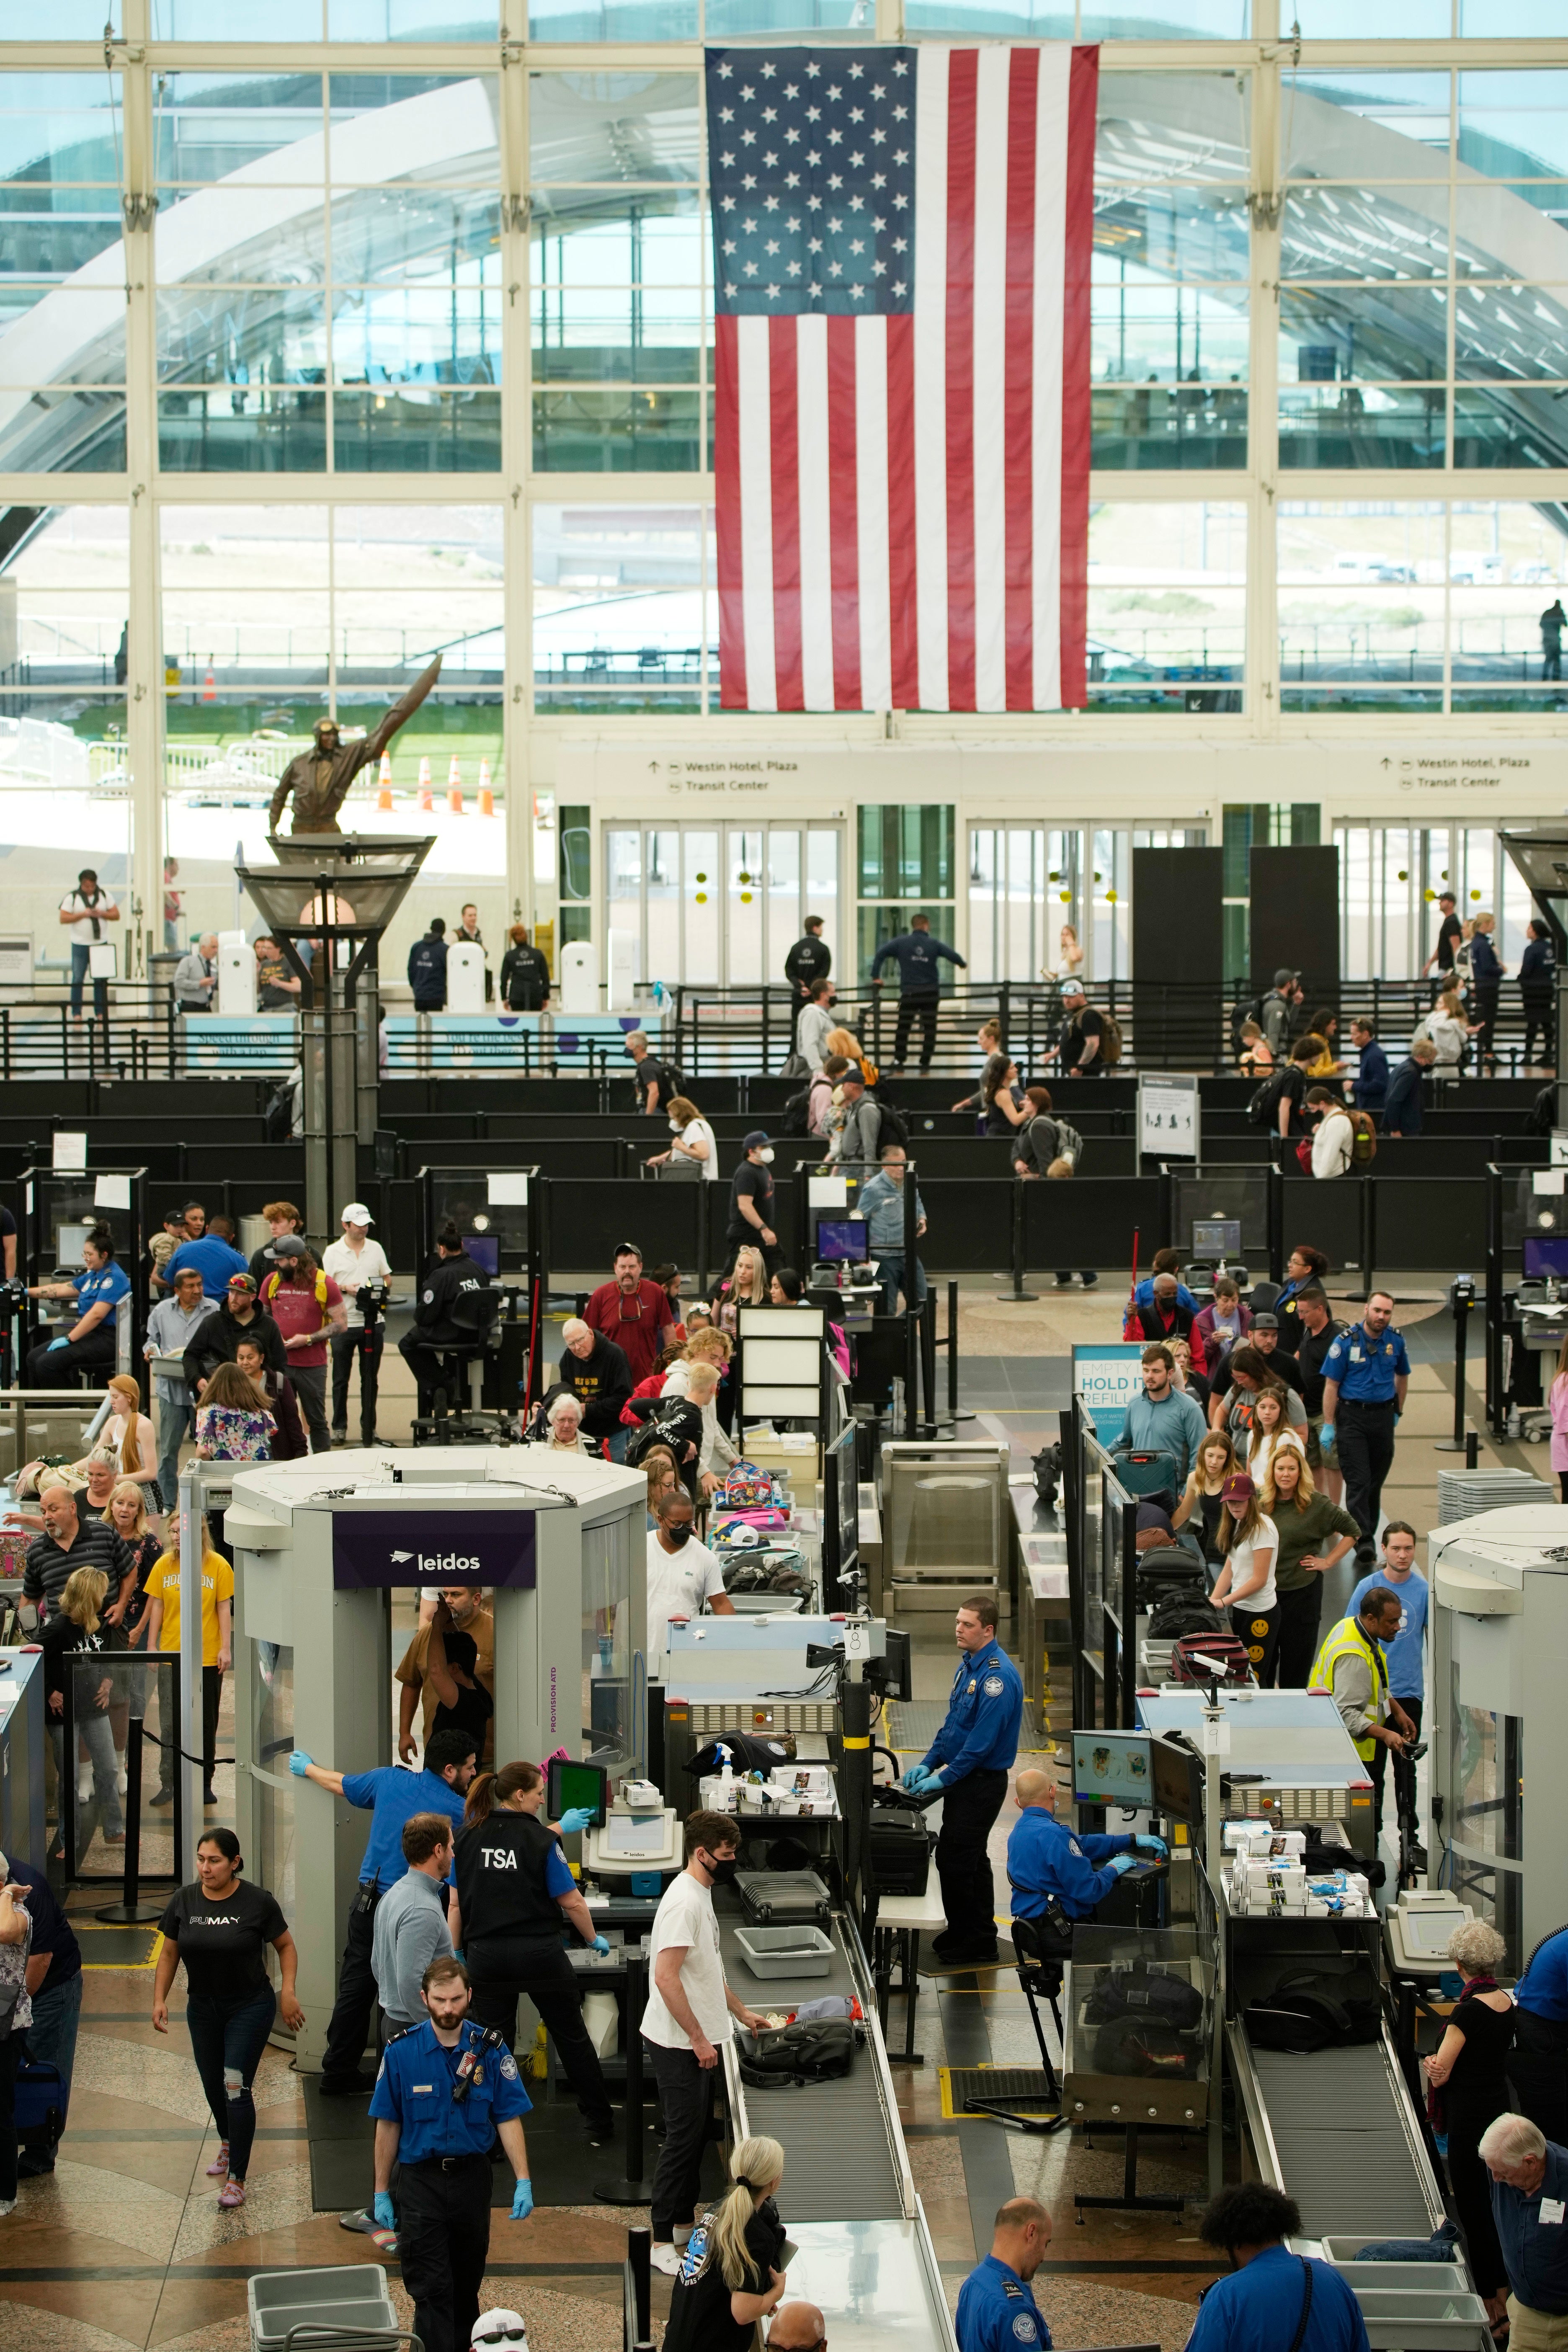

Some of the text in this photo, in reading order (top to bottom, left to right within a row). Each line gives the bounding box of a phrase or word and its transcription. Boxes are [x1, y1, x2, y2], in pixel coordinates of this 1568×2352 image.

[686, 761, 798, 772] Westin Hotel, Plaza
[1417, 758, 1530, 768] Westin Hotel, Plaza
[686, 781, 769, 790] Transit Center
[1418, 777, 1501, 787] Transit Center
[459, 1279, 480, 1291] TSA
[1083, 1363, 1132, 1375] EMPTY
[1083, 1378, 1128, 1390] HOLD
[1083, 1393, 1130, 1404] REFILL
[418, 1553, 480, 1571] leidos
[851, 1632, 861, 1650] 8
[1209, 1728, 1218, 1746] 9
[481, 1848, 518, 1869] TSA
[489, 2031, 498, 2041] TSA
